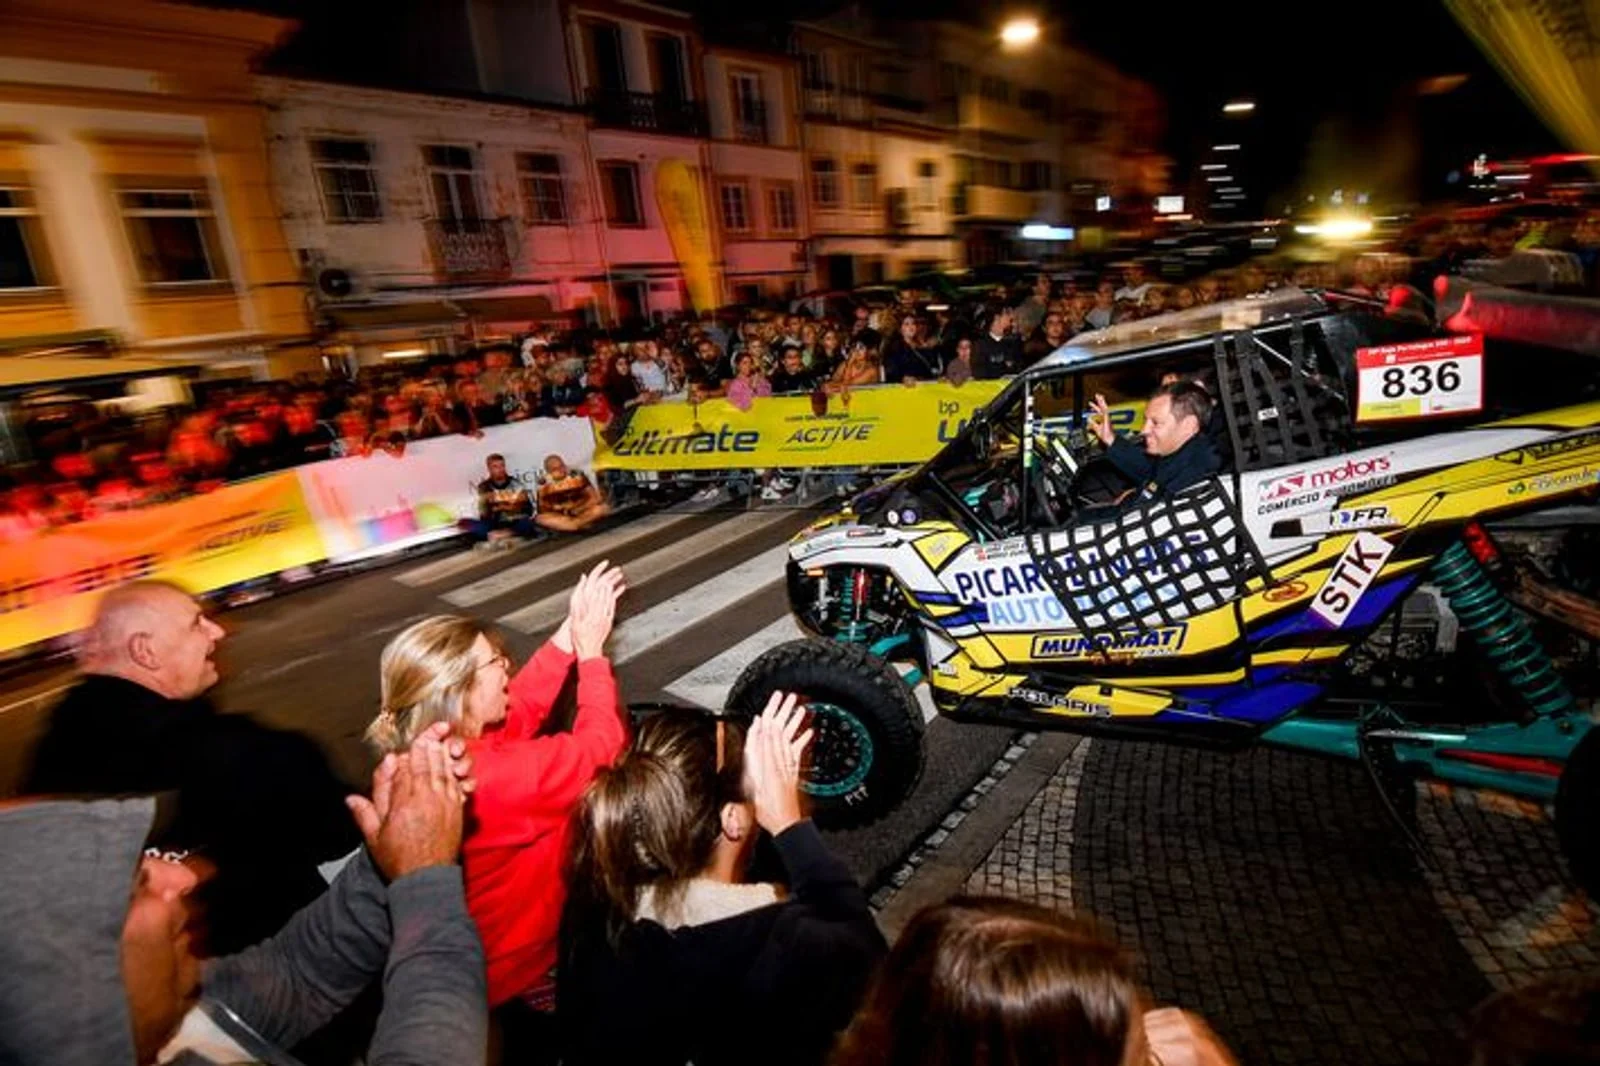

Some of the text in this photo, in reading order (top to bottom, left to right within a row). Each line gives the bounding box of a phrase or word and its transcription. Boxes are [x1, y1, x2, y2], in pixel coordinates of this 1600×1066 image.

[1382, 361, 1461, 398] 836
[939, 400, 960, 415] bp
[613, 423, 760, 456] ultimate
[786, 424, 875, 443] ACTIVE
[1311, 456, 1391, 487] motors
[1257, 492, 1320, 516] COMÉRCIO
[1320, 539, 1384, 614] STK
